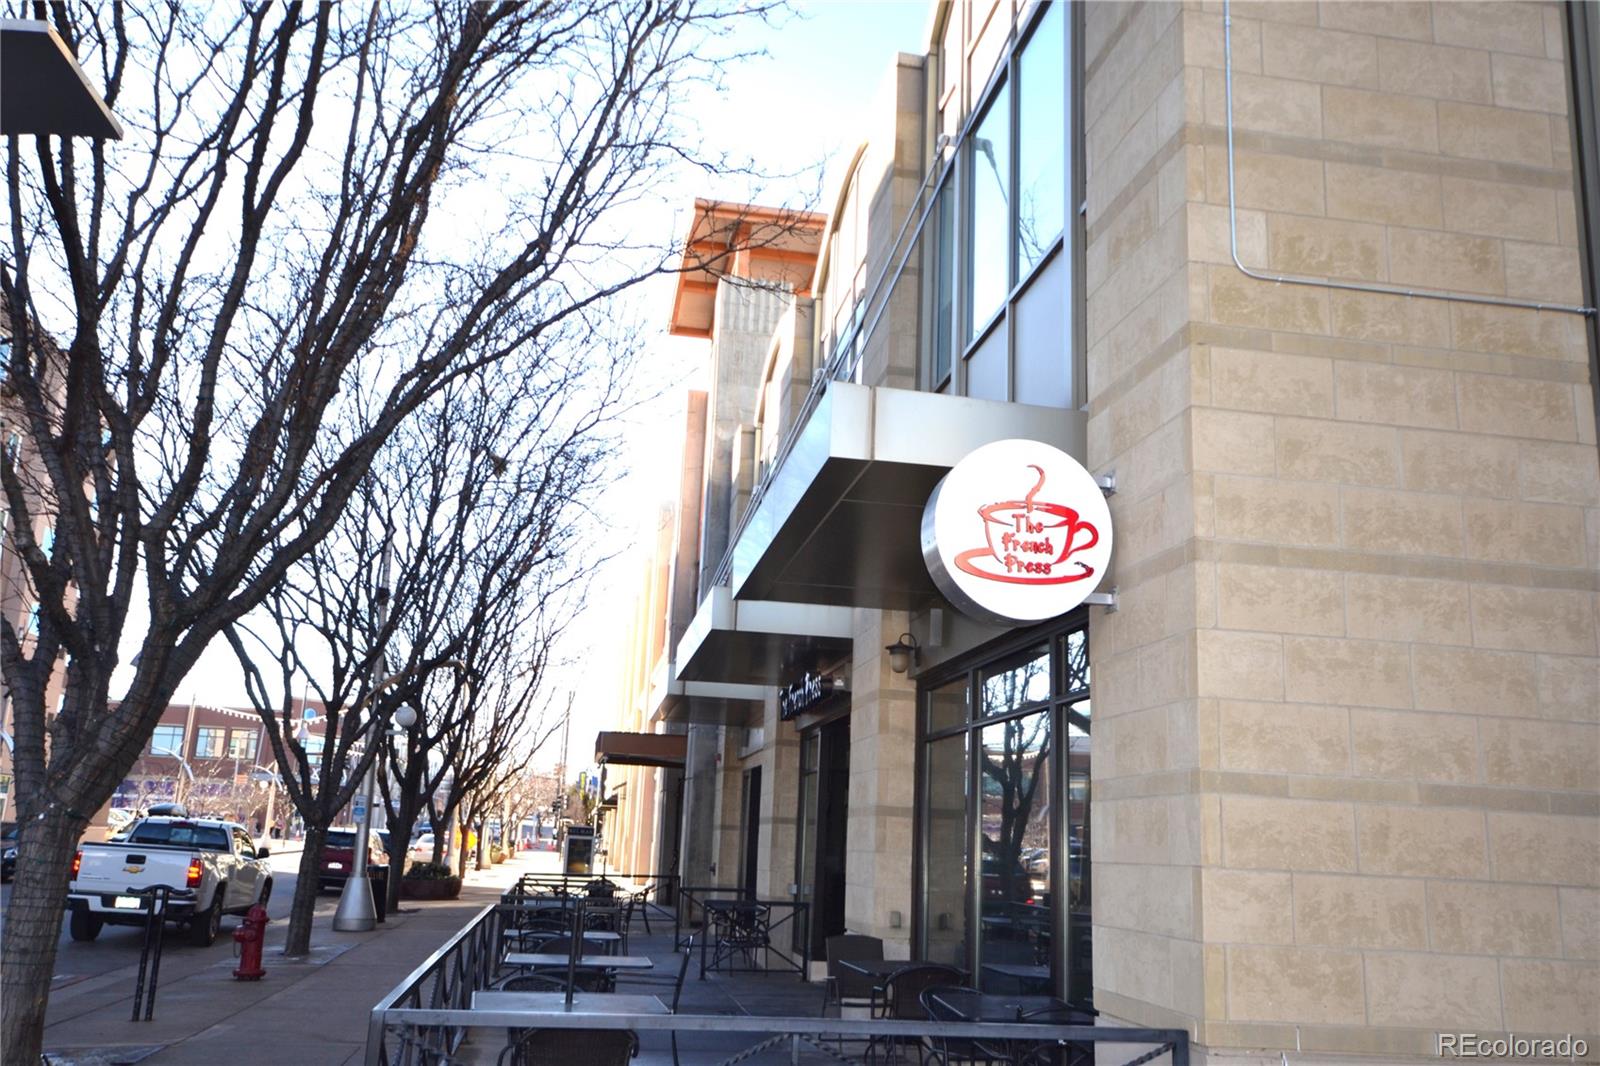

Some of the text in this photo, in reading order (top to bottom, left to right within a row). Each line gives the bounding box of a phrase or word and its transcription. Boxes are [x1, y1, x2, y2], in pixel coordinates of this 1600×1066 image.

[1012, 514, 1044, 534] The
[1001, 532, 1053, 555] French
[1003, 553, 1052, 575] Press
